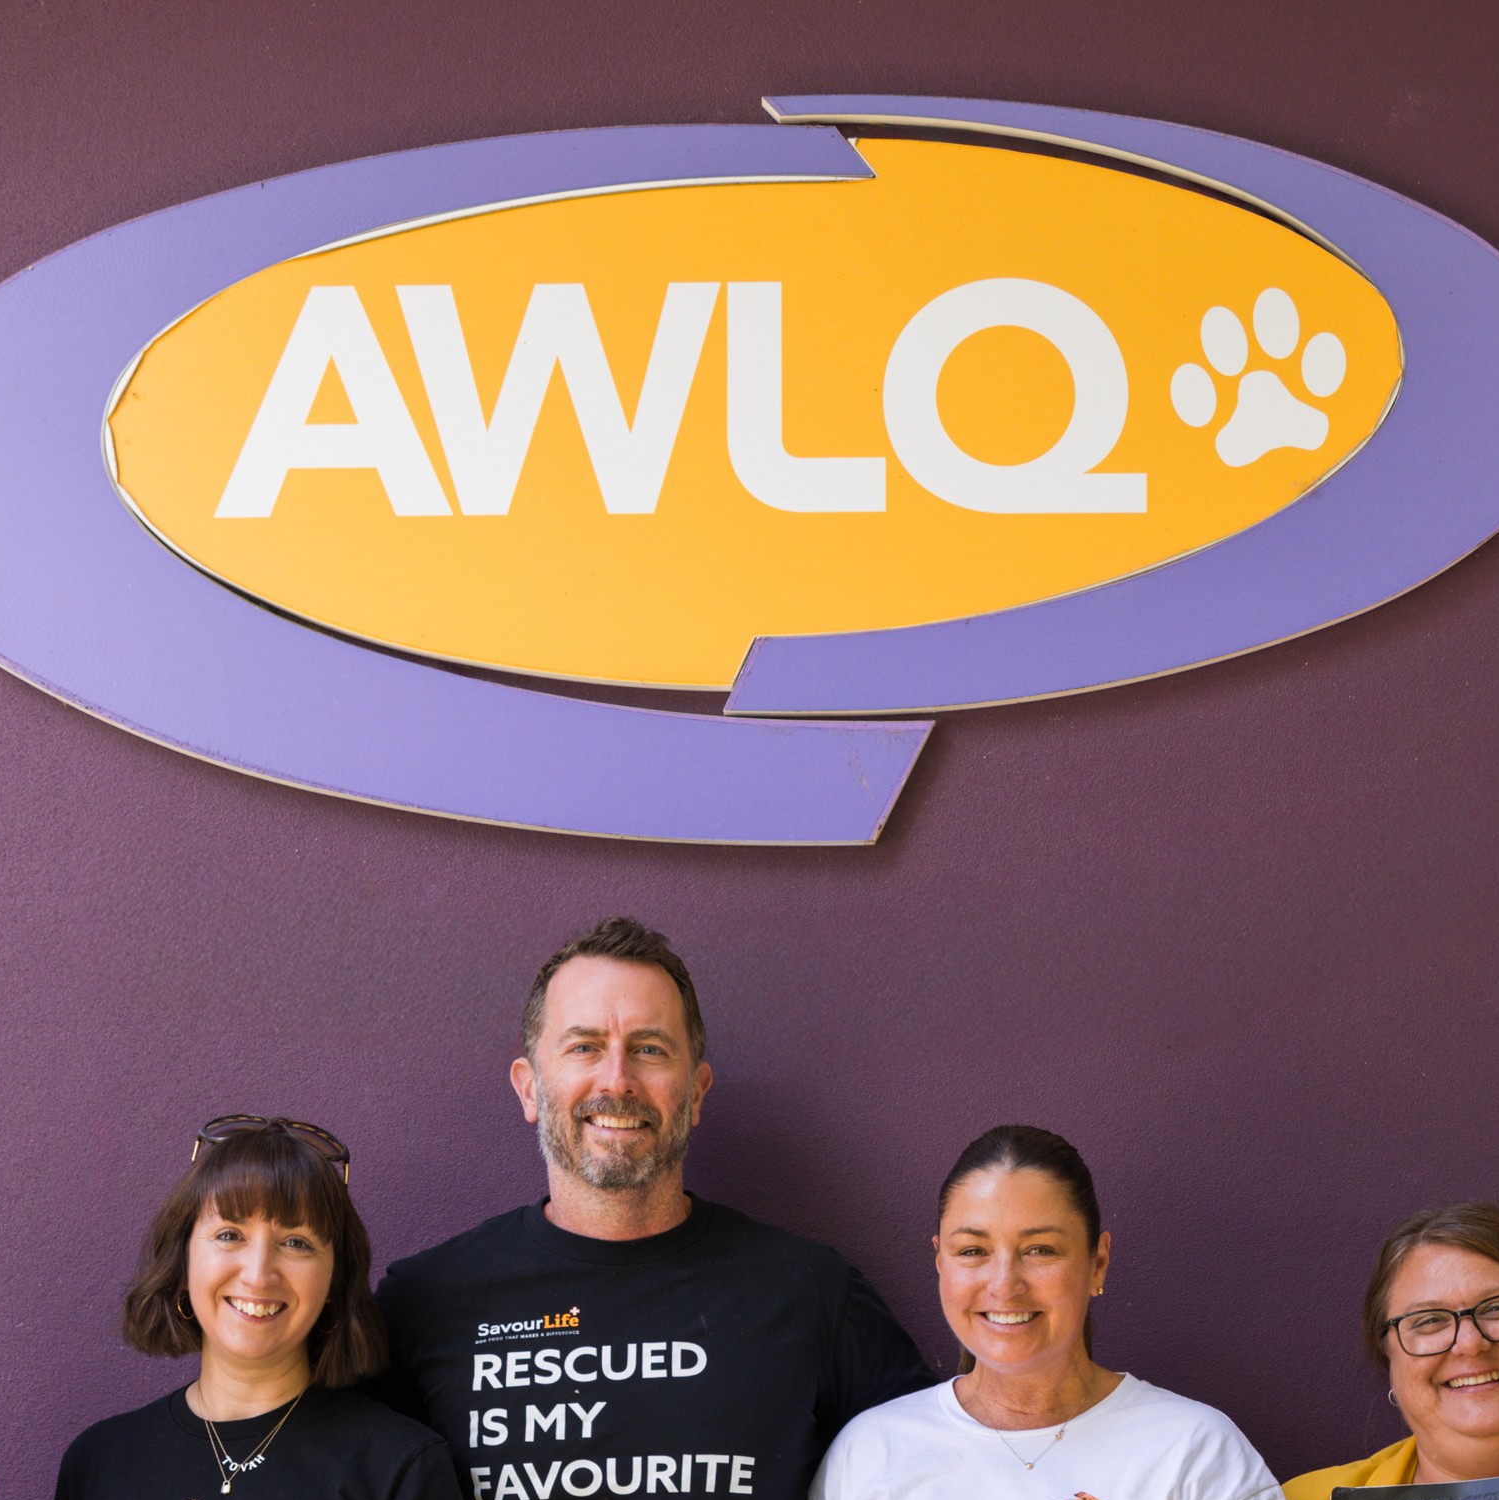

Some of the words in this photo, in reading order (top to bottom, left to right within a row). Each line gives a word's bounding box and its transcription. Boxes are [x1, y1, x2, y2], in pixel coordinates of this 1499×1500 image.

[213, 278, 1147, 518] AWLQ
[472, 1341, 708, 1391] RESCUED
[469, 1407, 509, 1448] IS
[524, 1401, 607, 1443] MY
[222, 1454, 266, 1472] TOVAH
